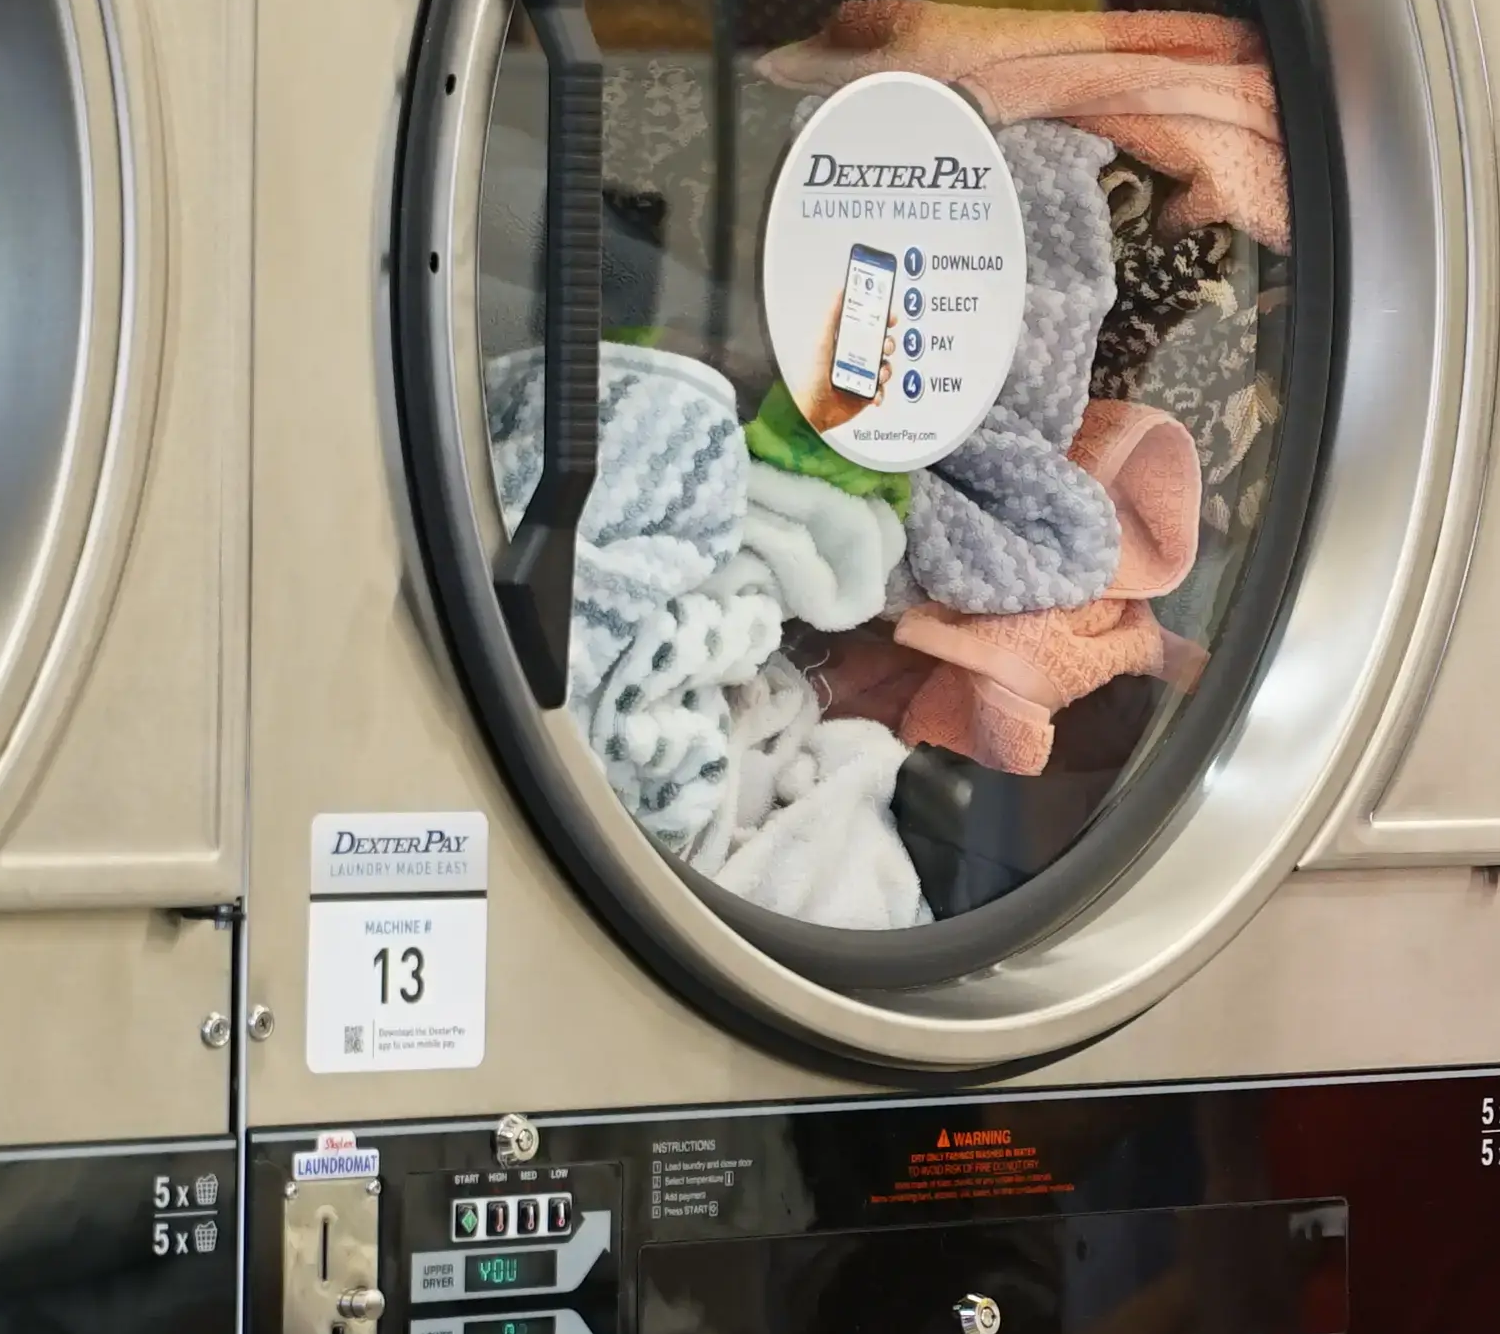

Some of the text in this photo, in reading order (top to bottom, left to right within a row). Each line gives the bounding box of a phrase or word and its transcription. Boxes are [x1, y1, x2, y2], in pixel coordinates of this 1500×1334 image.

[801, 200, 992, 222] LAUNDRY MADE EASY
[931, 254, 1004, 272] DOWNLOAD
[931, 296, 979, 313] SELECT
[930, 335, 955, 352] PAY
[930, 377, 963, 393] VIEW
[853, 428, 937, 444] Visit DexterPay.com
[329, 861, 469, 877] LAUNDRY MADE EASY
[365, 920, 433, 935] MACHINE #
[373, 946, 426, 1005] 13
[1481, 1098, 1493, 1125] 5
[652, 1140, 716, 1153] INSTRUCTIONS
[953, 1130, 1011, 1147] WARNING
[1481, 1139, 1493, 1165] 5
[298, 1155, 377, 1175] LAUNDROMAT
[454, 1169, 568, 1184] START HIGH MED LOW
[154, 1176, 189, 1208] 5 x
[665, 1193, 677, 1201] Add
[153, 1223, 189, 1255] 5 x
[424, 1264, 454, 1275] UPPER
[480, 1258, 518, 1283] YOU
[423, 1277, 454, 1289] DRYER
